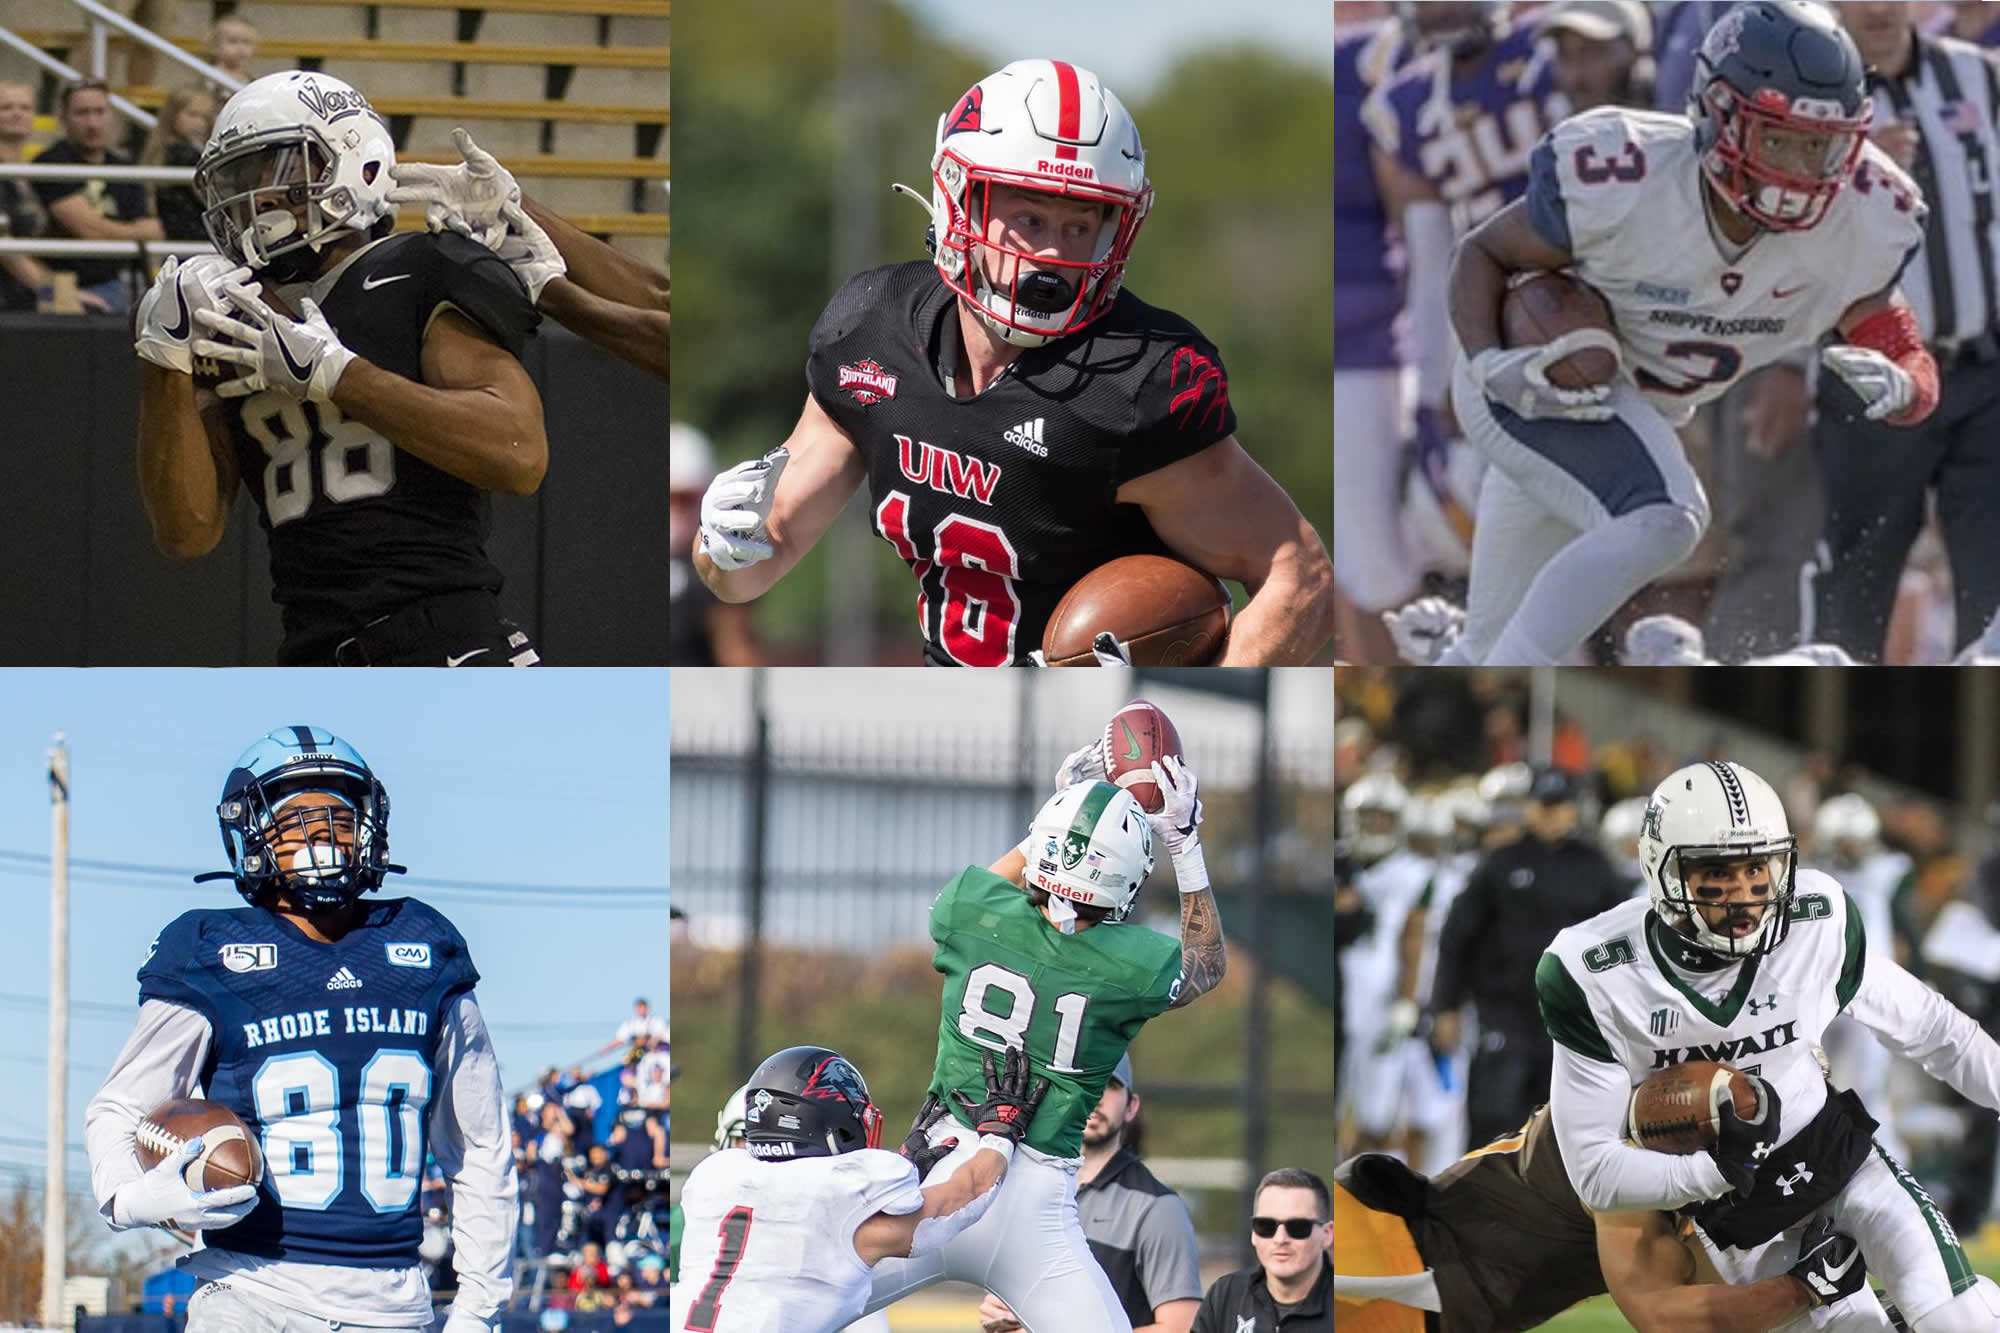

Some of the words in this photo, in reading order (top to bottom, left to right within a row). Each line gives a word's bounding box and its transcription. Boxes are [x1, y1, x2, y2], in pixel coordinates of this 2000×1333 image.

[1037, 160, 1094, 180] Riddell
[1575, 141, 1647, 185] 3
[839, 366, 897, 397] SOUTHLAND
[240, 384, 397, 528] 88
[1003, 430, 1049, 458] adidas
[893, 433, 1001, 506] UIW
[877, 489, 1023, 667] 16
[1037, 874, 1095, 904] Riddell
[1089, 867, 1102, 882] 81
[218, 944, 277, 972] 150
[1582, 935, 1638, 973] 5
[327, 979, 364, 991] adidas
[243, 1009, 331, 1048] RHODE
[344, 1007, 428, 1036] ISLAND
[958, 961, 1089, 1073] 81
[252, 1048, 432, 1214] 80
[683, 1205, 754, 1333] 1
